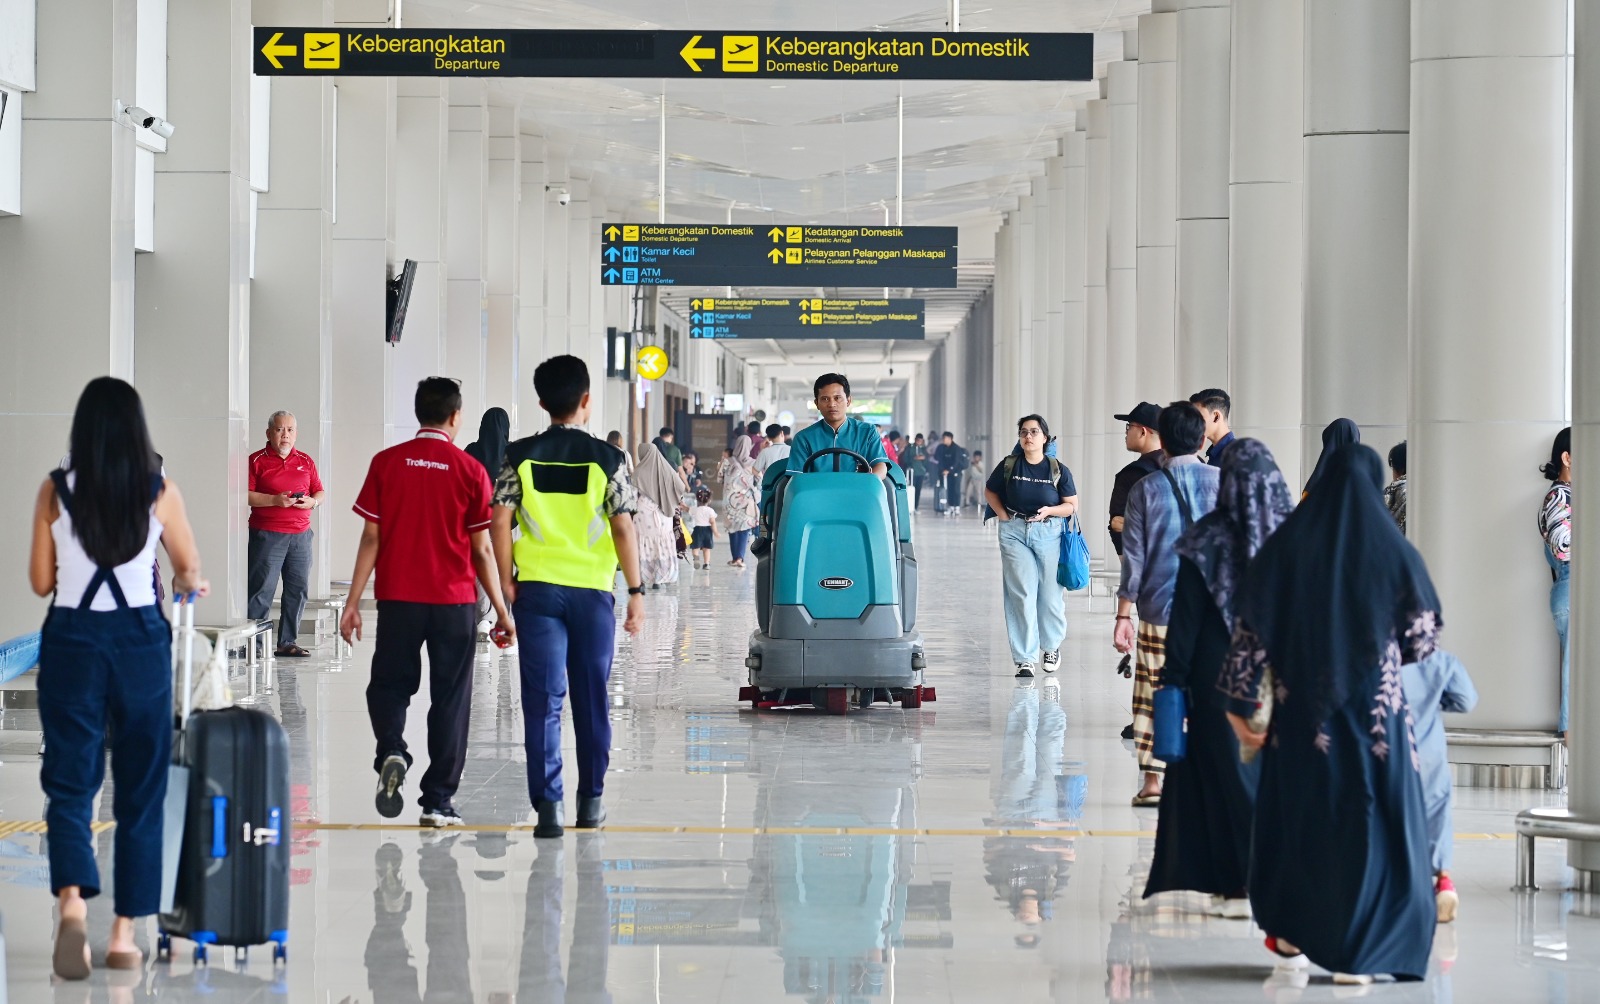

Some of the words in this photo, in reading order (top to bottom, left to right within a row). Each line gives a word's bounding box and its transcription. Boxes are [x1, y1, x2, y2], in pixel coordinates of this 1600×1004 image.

[348, 33, 505, 58] Keberangkatan
[766, 37, 924, 60] Keberangkatan
[931, 38, 1030, 58] Domestik
[434, 57, 500, 73] Departure
[766, 60, 829, 72] Domestic
[833, 60, 899, 75] Departure
[641, 227, 708, 236] Keberangkatan
[711, 227, 754, 236] Domestik
[805, 228, 858, 238] Kedatangan
[861, 228, 903, 237] Domestik
[641, 247, 670, 256] Kamar
[673, 247, 695, 256] Kecil
[805, 249, 850, 258] Pelayanan
[853, 249, 900, 259] Pelanggan
[903, 249, 946, 259] Maskapai
[641, 268, 661, 277] ATM
[856, 313, 887, 321] Pelanggan
[405, 458, 449, 470] Trolleyman
